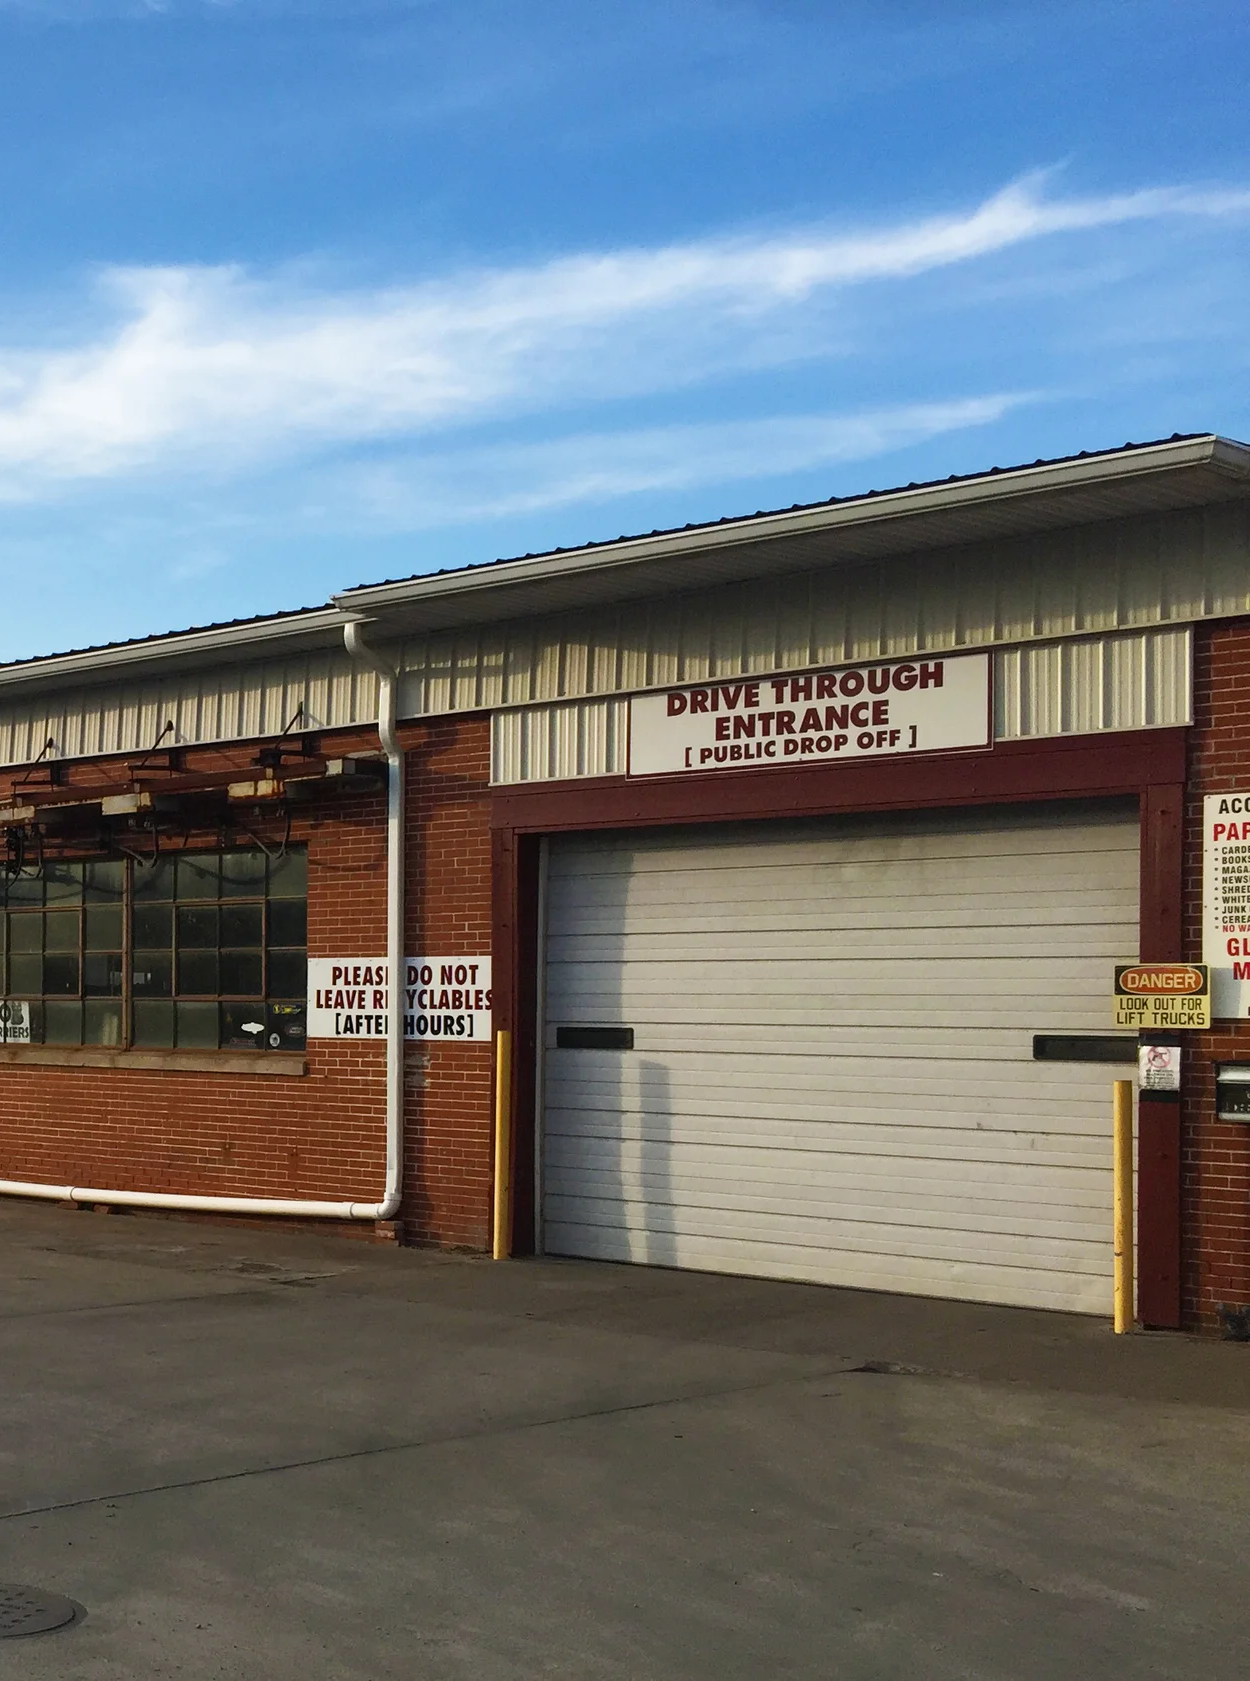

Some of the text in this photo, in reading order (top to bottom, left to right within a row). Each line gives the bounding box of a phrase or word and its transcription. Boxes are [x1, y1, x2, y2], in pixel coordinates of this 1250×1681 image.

[667, 661, 944, 717] DRIVE THROUGH
[715, 699, 890, 742] ENTRANCE
[700, 740, 776, 764] PUBLIC
[784, 734, 849, 756] DROP
[1222, 905, 1246, 914] JUNK
[1222, 924, 1235, 933] NO
[332, 964, 479, 986] PLEAS DO NOT
[1127, 973, 1196, 988] DANGER
[316, 989, 366, 1010] LEAVE
[1119, 997, 1202, 1011] LOOK OUT FOR
[1116, 1012, 1205, 1025] LIFT TRUCKS
